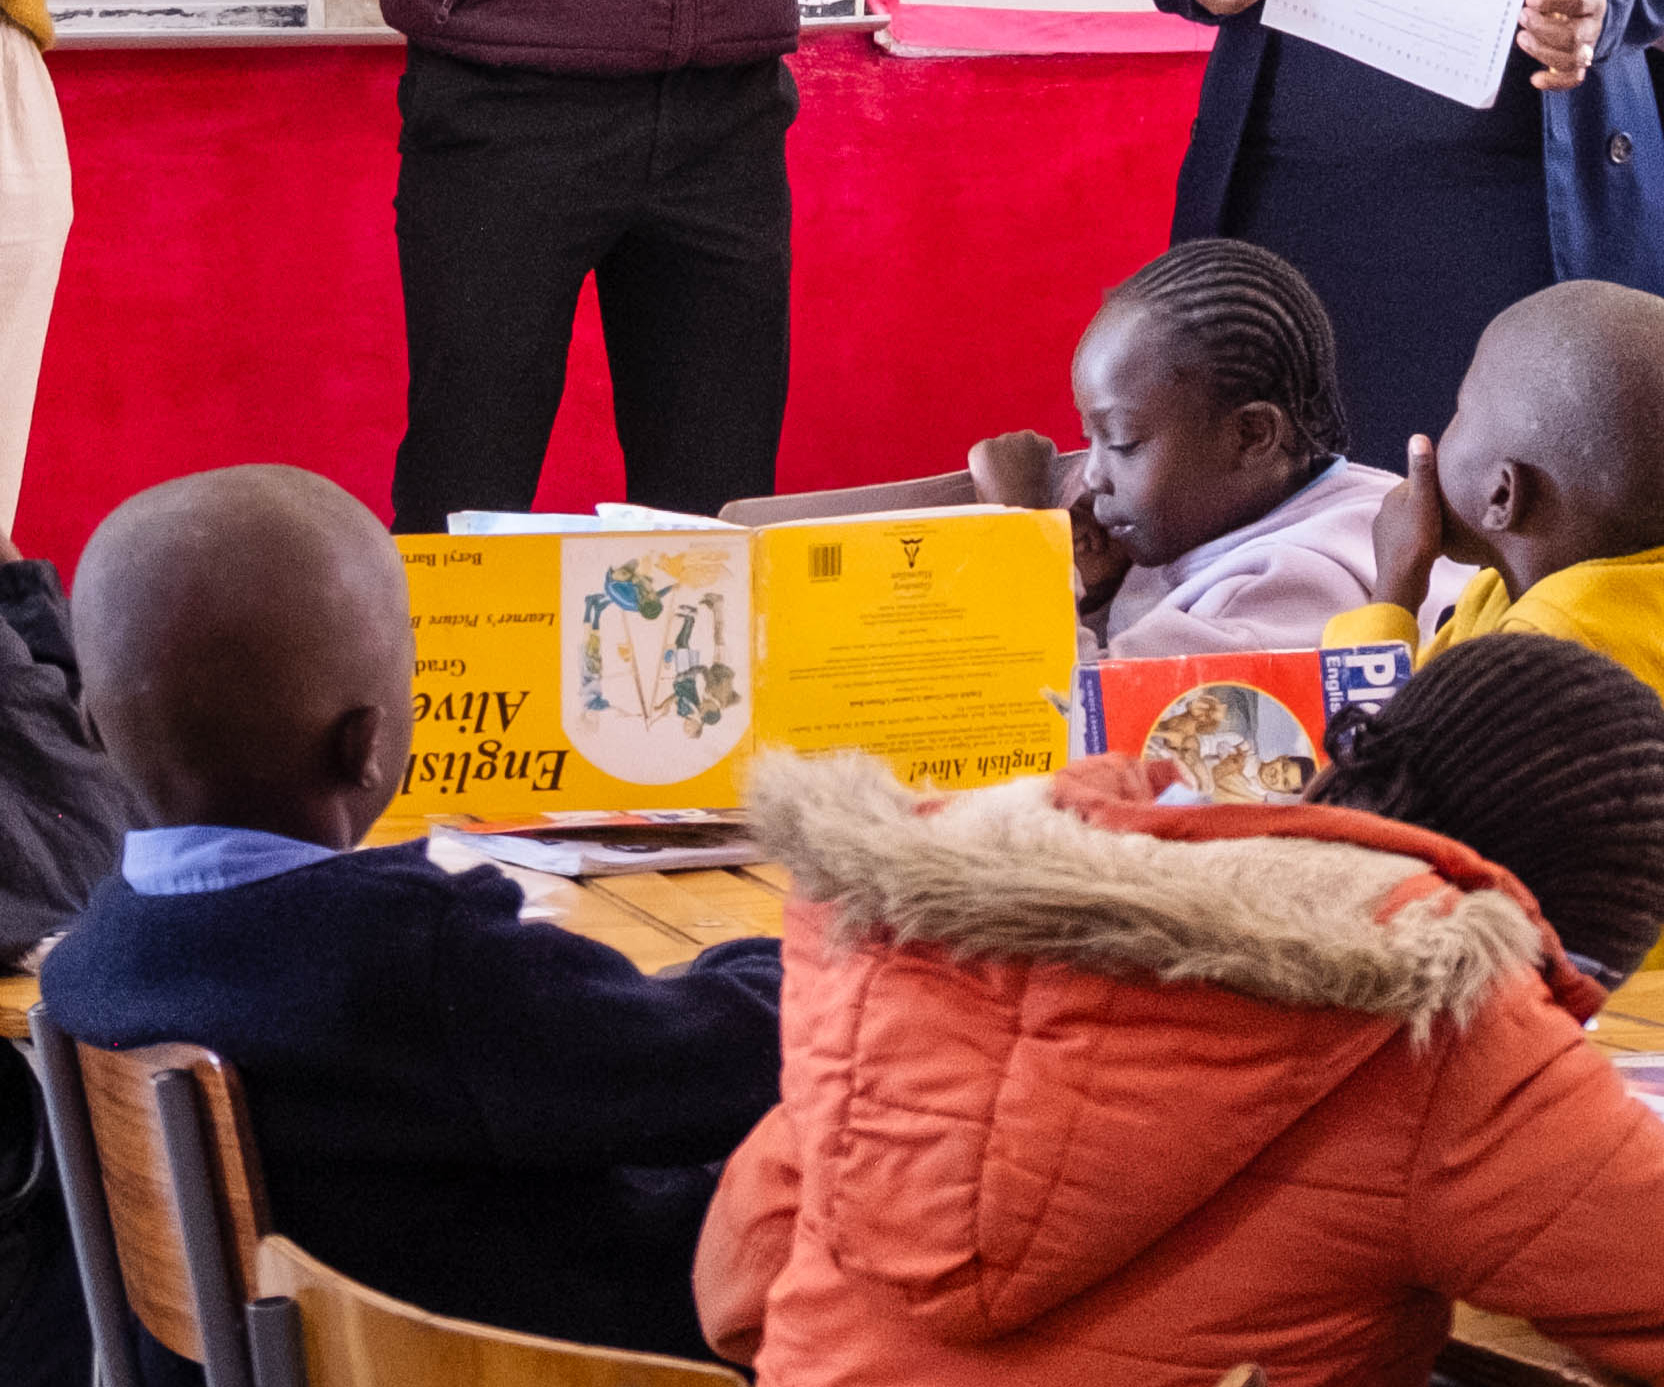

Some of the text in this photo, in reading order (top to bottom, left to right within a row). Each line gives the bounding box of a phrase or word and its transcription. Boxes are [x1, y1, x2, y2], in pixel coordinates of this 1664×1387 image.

[442, 550, 483, 567] Beryl
[429, 614, 479, 630] Picture
[485, 611, 556, 629] Learner's
[413, 659, 467, 678] Grad
[1325, 655, 1344, 714] Englis
[908, 748, 1053, 782] English Alive!
